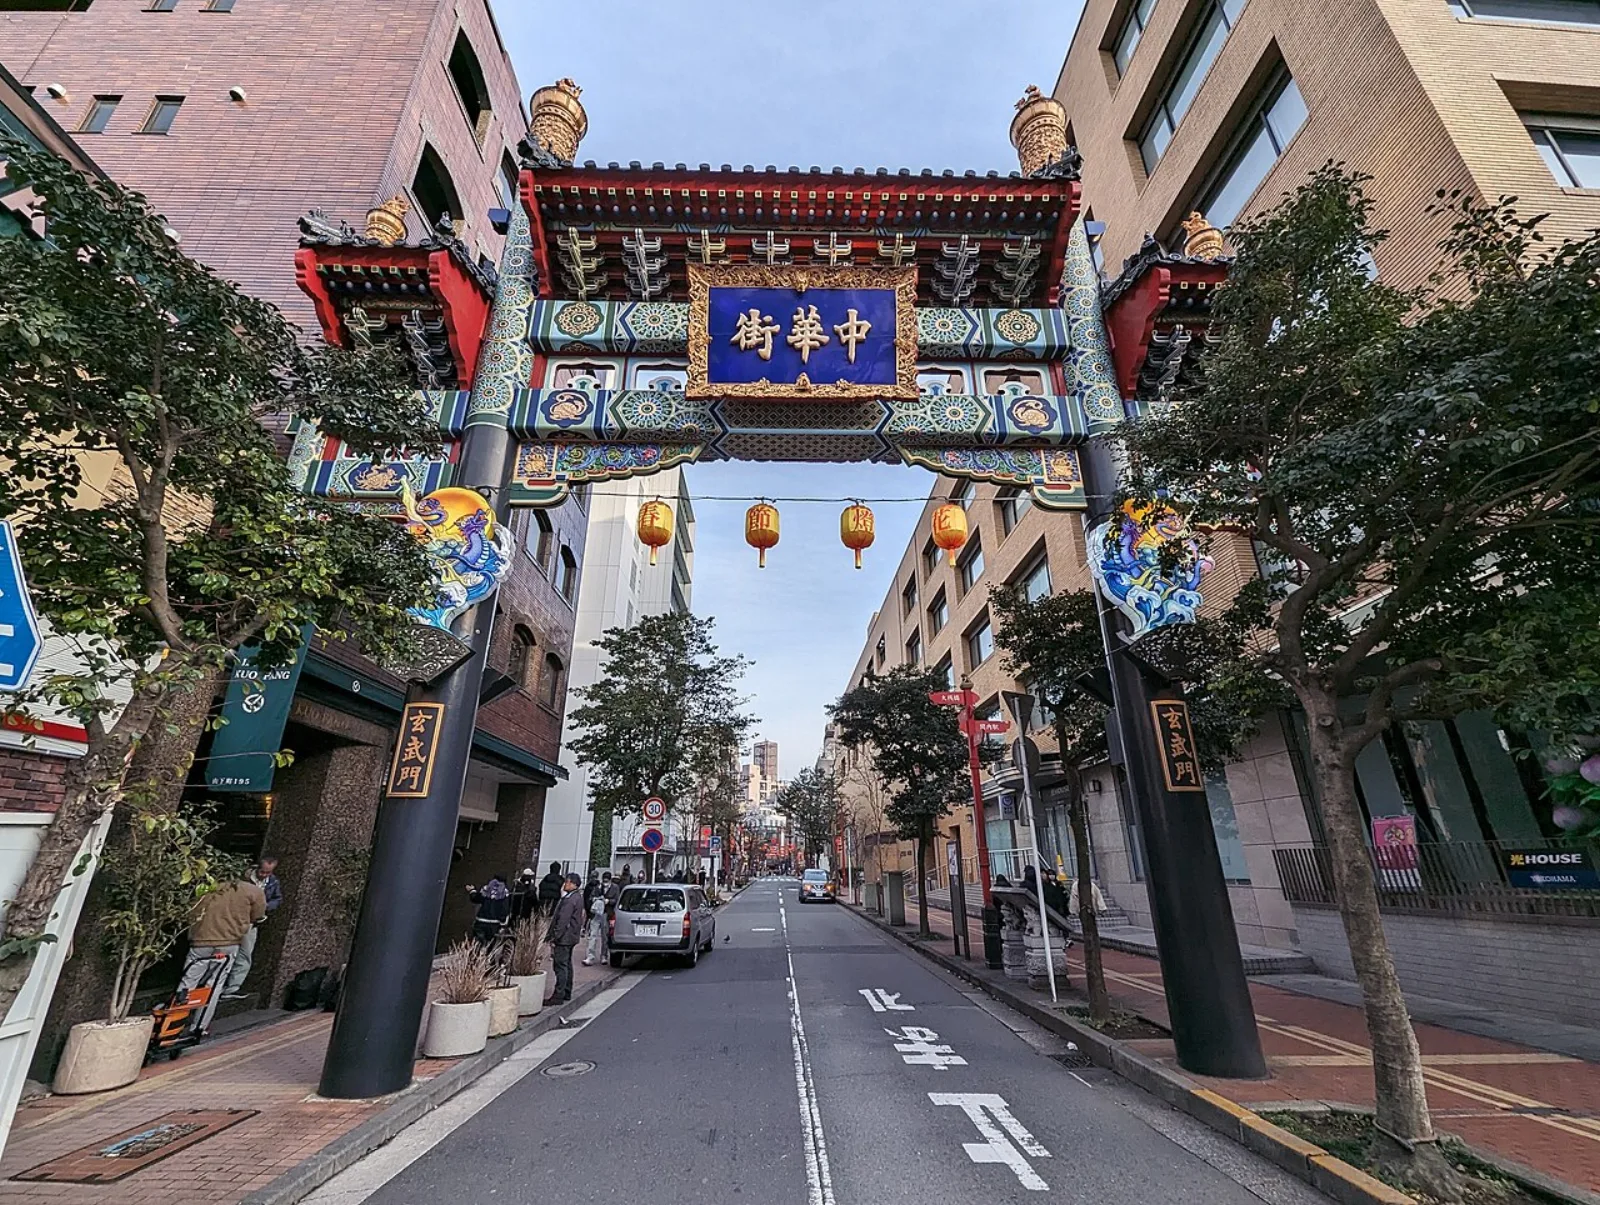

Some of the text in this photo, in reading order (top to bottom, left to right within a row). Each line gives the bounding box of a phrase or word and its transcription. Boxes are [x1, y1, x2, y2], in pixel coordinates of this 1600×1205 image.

[730, 304, 872, 364] 中華街
[749, 507, 771, 530] 節
[396, 709, 433, 790] 玄武門
[1162, 707, 1196, 784] 玄武門
[648, 804, 661, 814] 30
